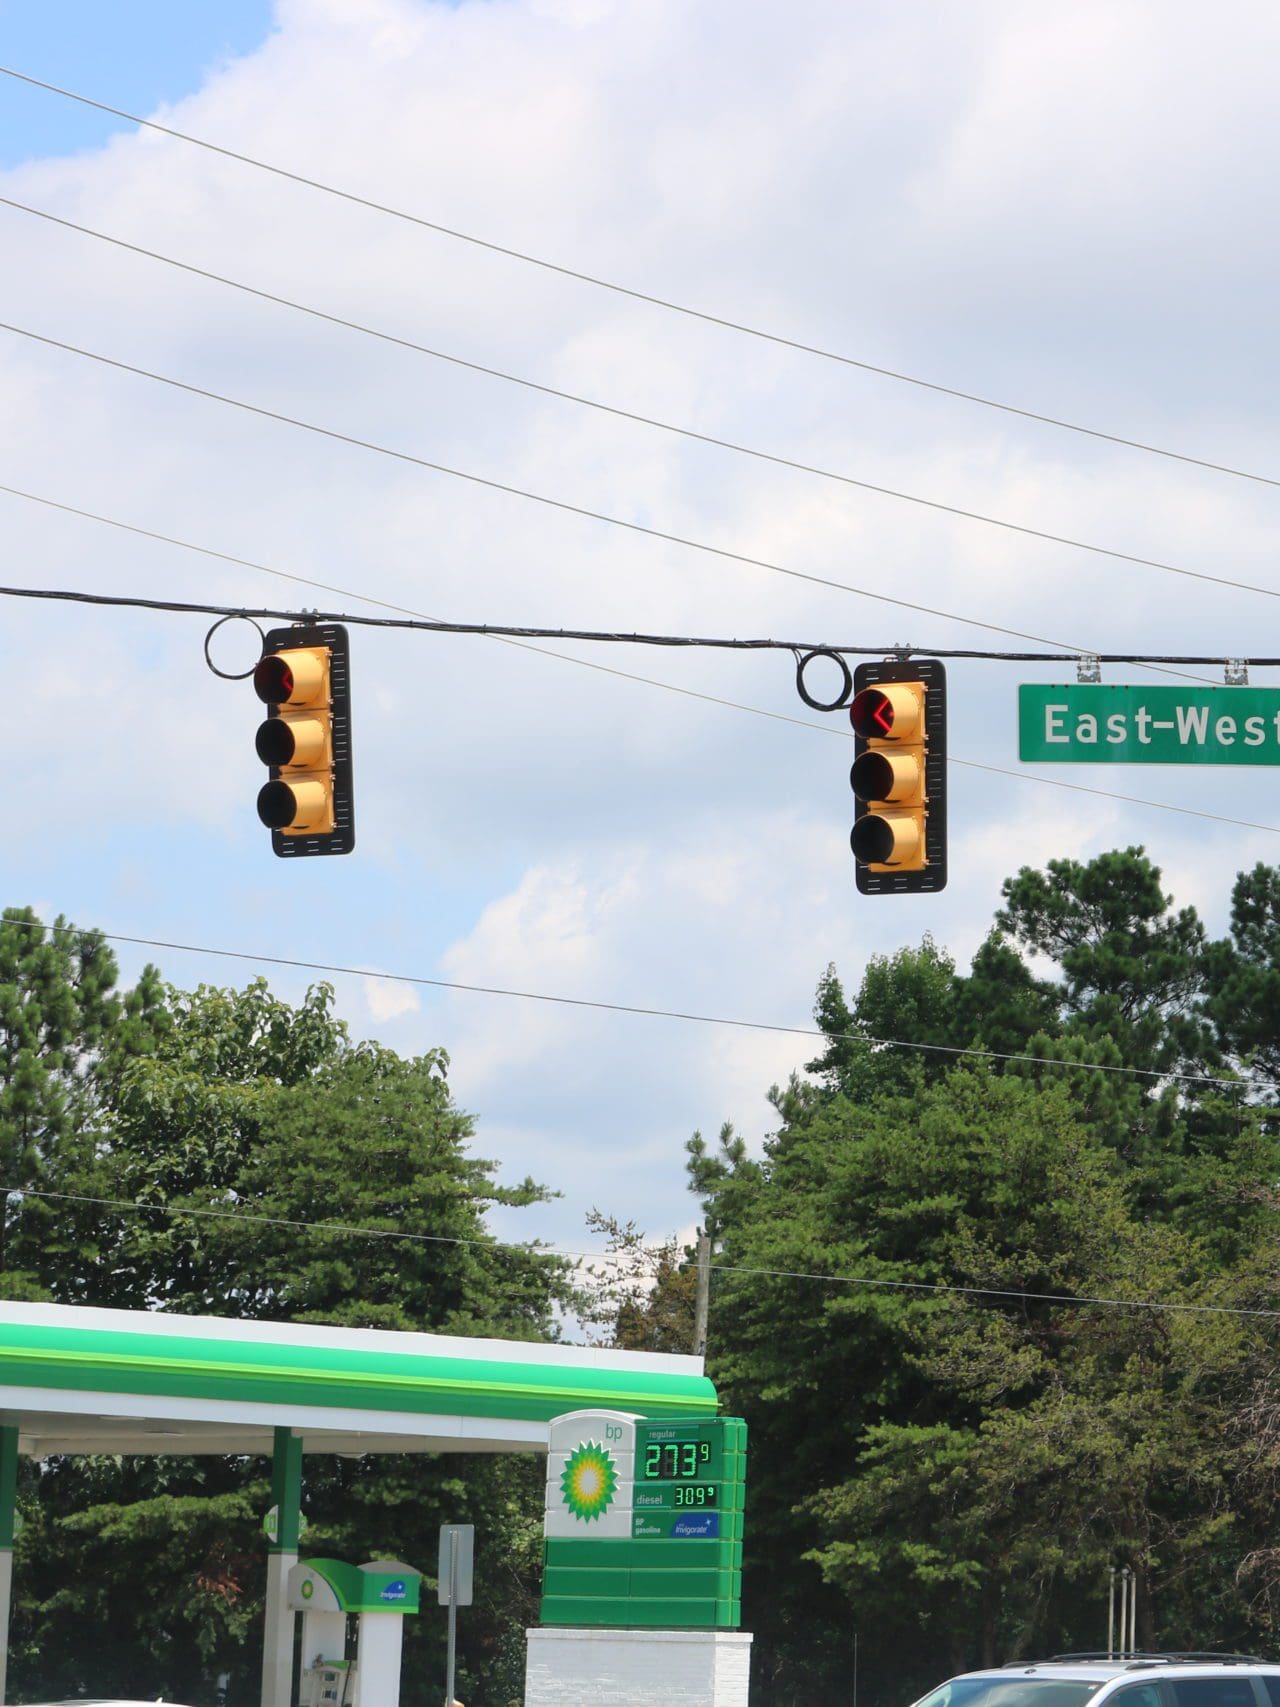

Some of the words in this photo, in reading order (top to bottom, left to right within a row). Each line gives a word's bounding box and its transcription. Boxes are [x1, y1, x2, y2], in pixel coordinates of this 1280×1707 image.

[606, 1423, 623, 1443] bp
[649, 1430, 676, 1439] regular
[636, 1495, 663, 1505] diesel
[635, 1518, 645, 1526] BP
[635, 1526, 661, 1535] gasoline
